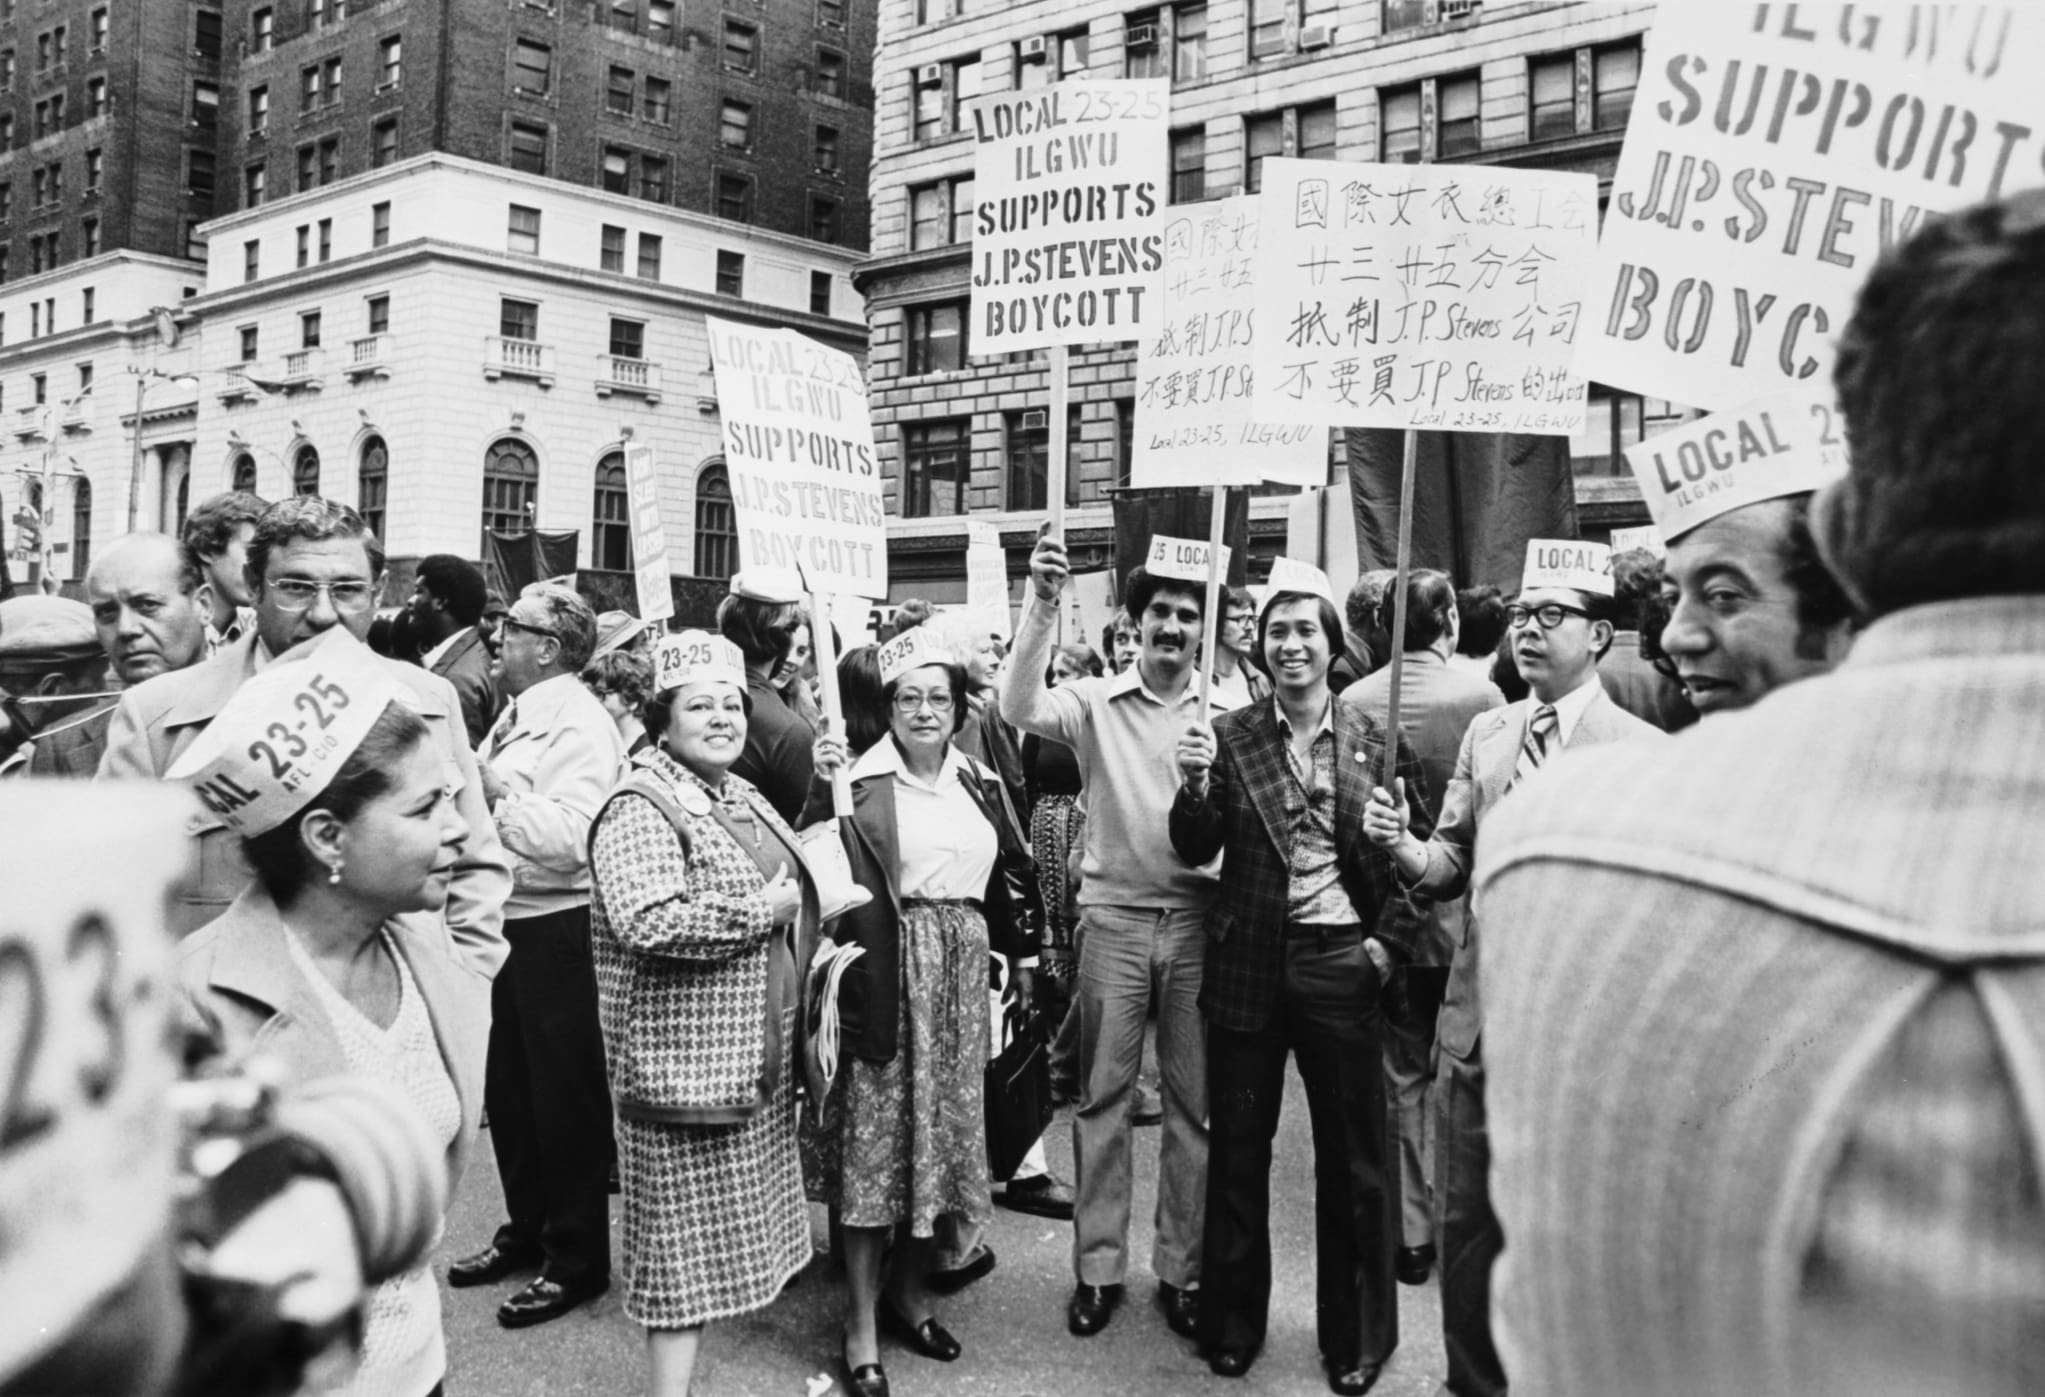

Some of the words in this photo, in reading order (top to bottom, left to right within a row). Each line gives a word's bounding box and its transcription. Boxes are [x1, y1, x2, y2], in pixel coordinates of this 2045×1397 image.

[973, 91, 1067, 143] LOCAL
[1074, 90, 1161, 122] 23-25
[1657, 53, 2045, 202] SUPPORT
[1015, 132, 1118, 181] ILGWU
[977, 181, 1156, 236] SUPPORTS
[986, 286, 1146, 337] BOYCOTT
[1605, 262, 1830, 380] BOYC
[711, 329, 803, 376] LOCAL
[751, 374, 842, 422] ILGWU
[728, 420, 872, 477] SUPPORTS
[1653, 411, 1791, 494] LOCAL
[1676, 473, 1735, 508] ILGWU
[750, 528, 873, 579] BOYCOTT
[1176, 545, 1210, 565] LOCA
[1538, 548, 1595, 572] LOCAL
[662, 643, 712, 672] 23-25
[880, 636, 914, 672] 23-25
[248, 673, 350, 779] 23-25
[194, 773, 261, 814] CAL
